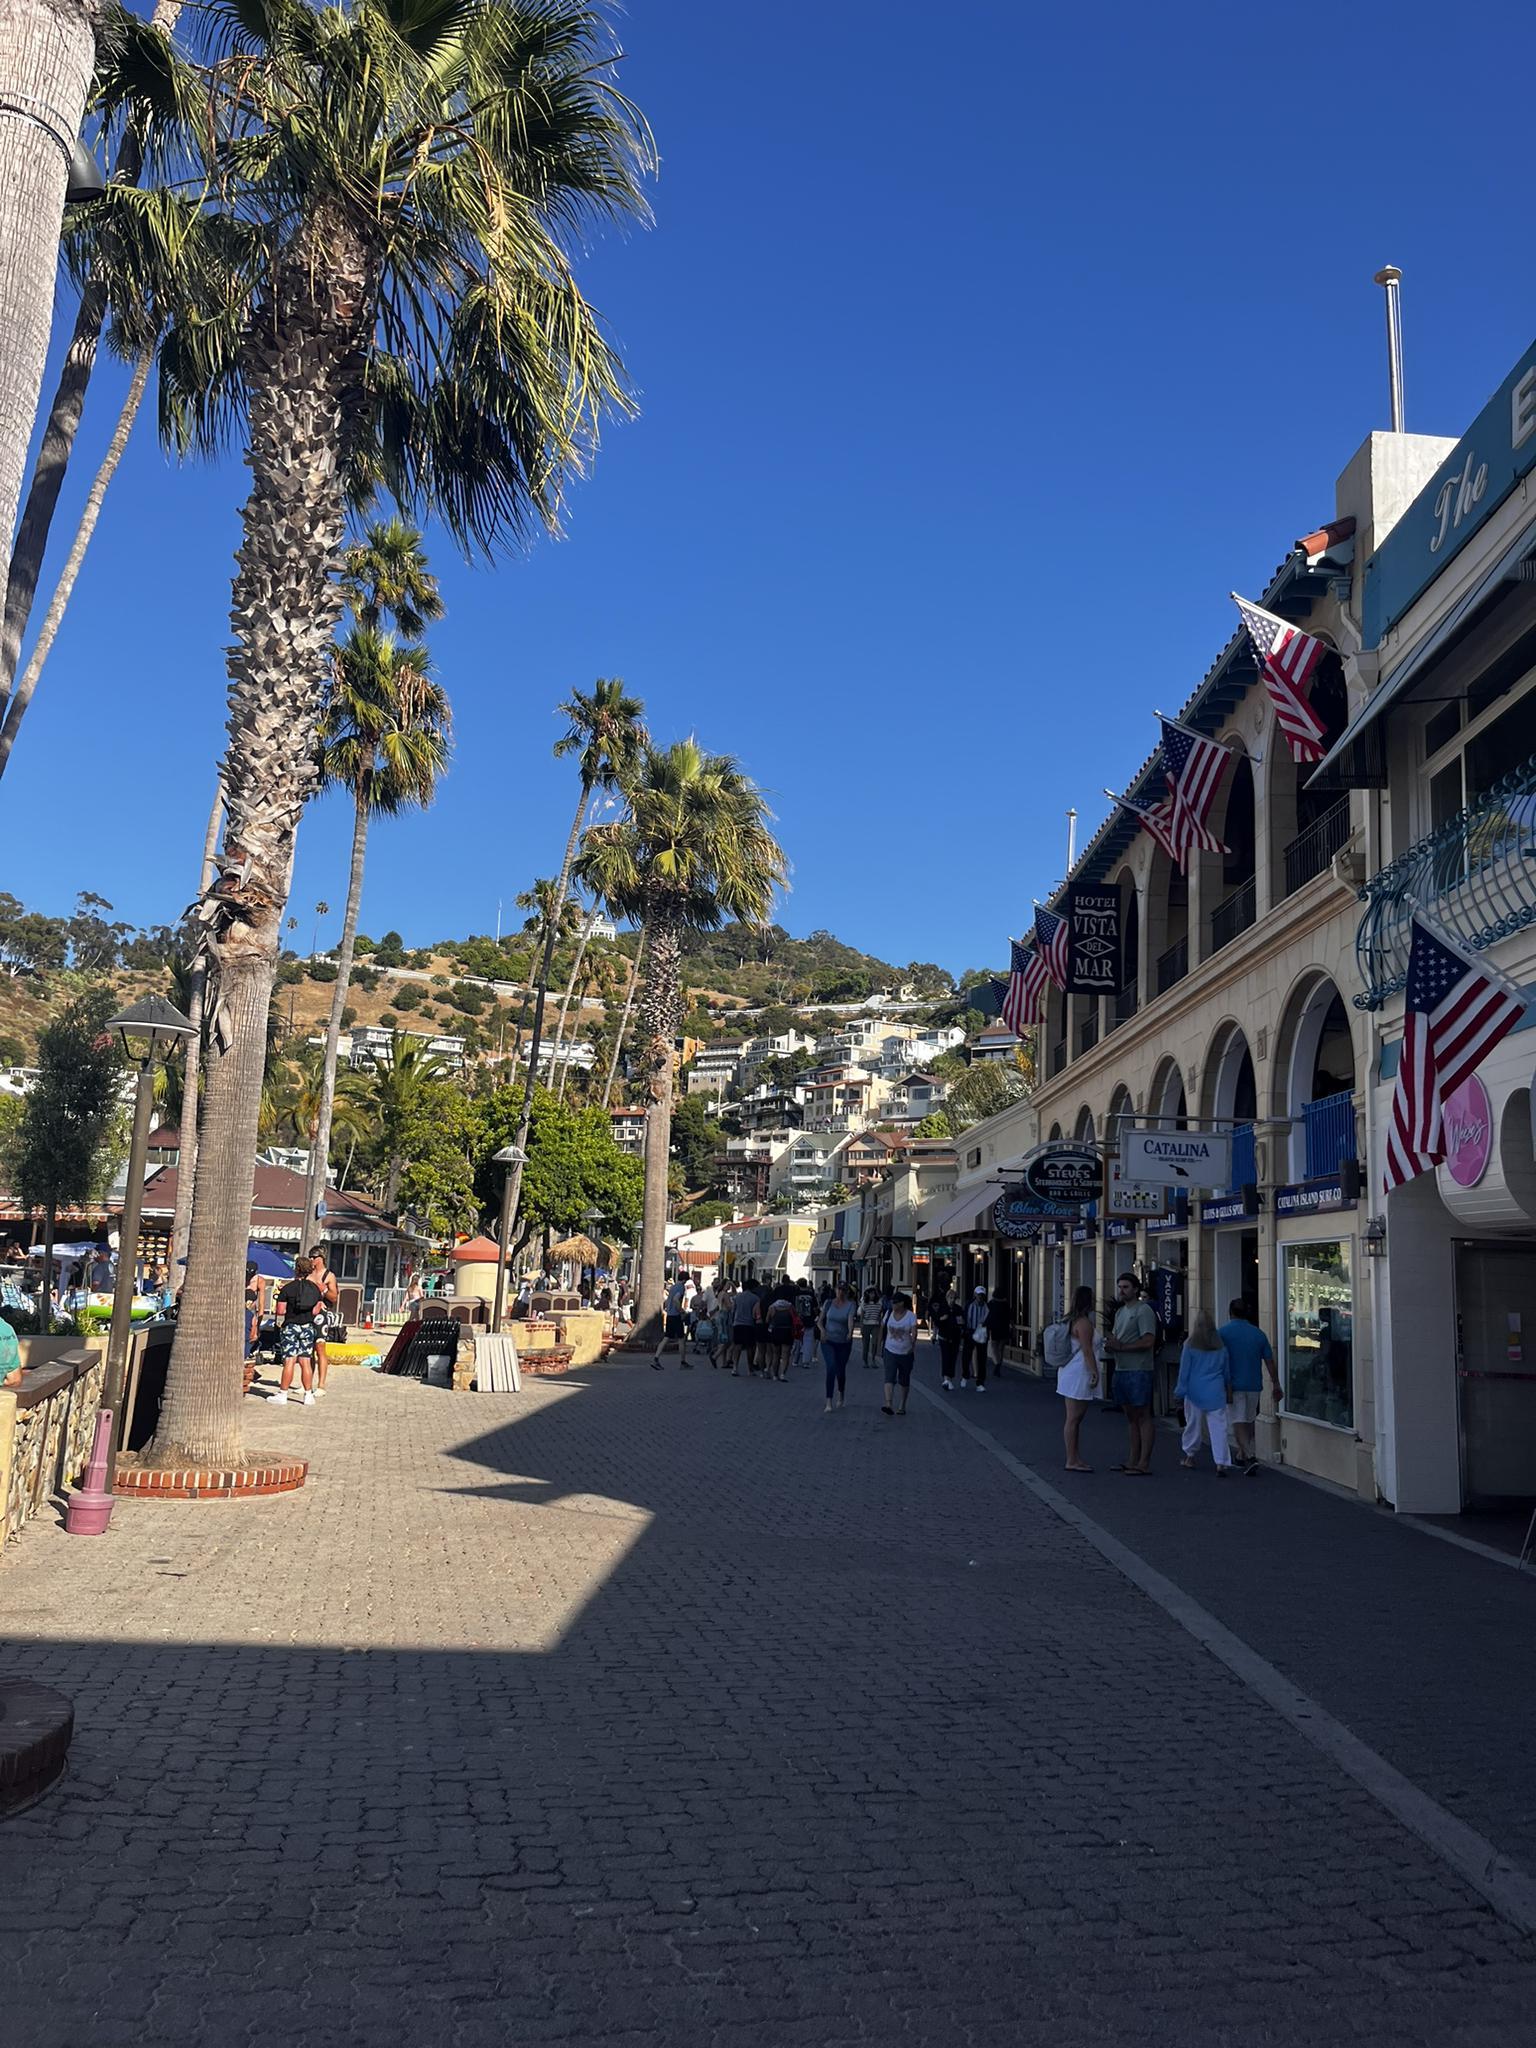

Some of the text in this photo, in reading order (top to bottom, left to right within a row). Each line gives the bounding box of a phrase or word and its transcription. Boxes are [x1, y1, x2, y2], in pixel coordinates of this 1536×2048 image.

[1430, 451, 1488, 553] The
[1074, 896, 1117, 907] HOTEL
[1073, 915, 1118, 936] VISTA
[1086, 941, 1104, 952] DEL
[1075, 958, 1114, 977] MAR
[1144, 1139, 1210, 1158] CATALINA
[1048, 1169, 1091, 1179] STEVE'S
[1009, 1200, 1073, 1216] Blue Rose
[1114, 1200, 1158, 1208] GULLS
[1278, 1194, 1299, 1208] CATALINA
[1300, 1192, 1318, 1205] ISLAND
[1319, 1189, 1332, 1203] SURF
[1164, 1274, 1173, 1325] VACANCY
